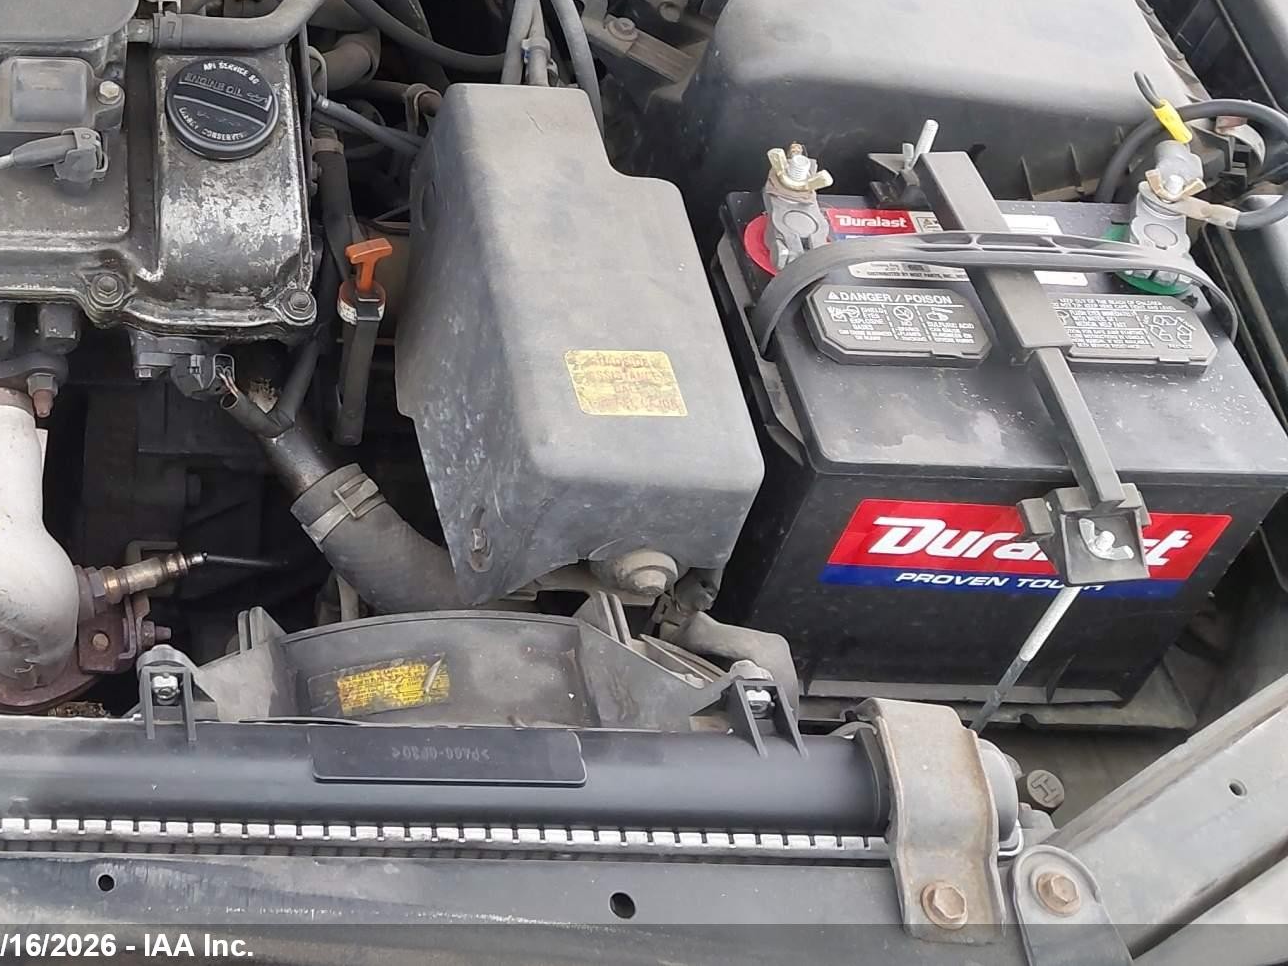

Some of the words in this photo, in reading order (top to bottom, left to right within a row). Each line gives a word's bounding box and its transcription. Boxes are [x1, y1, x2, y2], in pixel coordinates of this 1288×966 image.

[218, 60, 249, 77] SERVICE
[184, 72, 225, 91] ENGINE
[225, 85, 243, 97] OIL
[835, 214, 908, 228] Duralast
[839, 291, 893, 302] DANGER
[903, 294, 953, 304] POISON
[895, 572, 1010, 587] PROVEN
